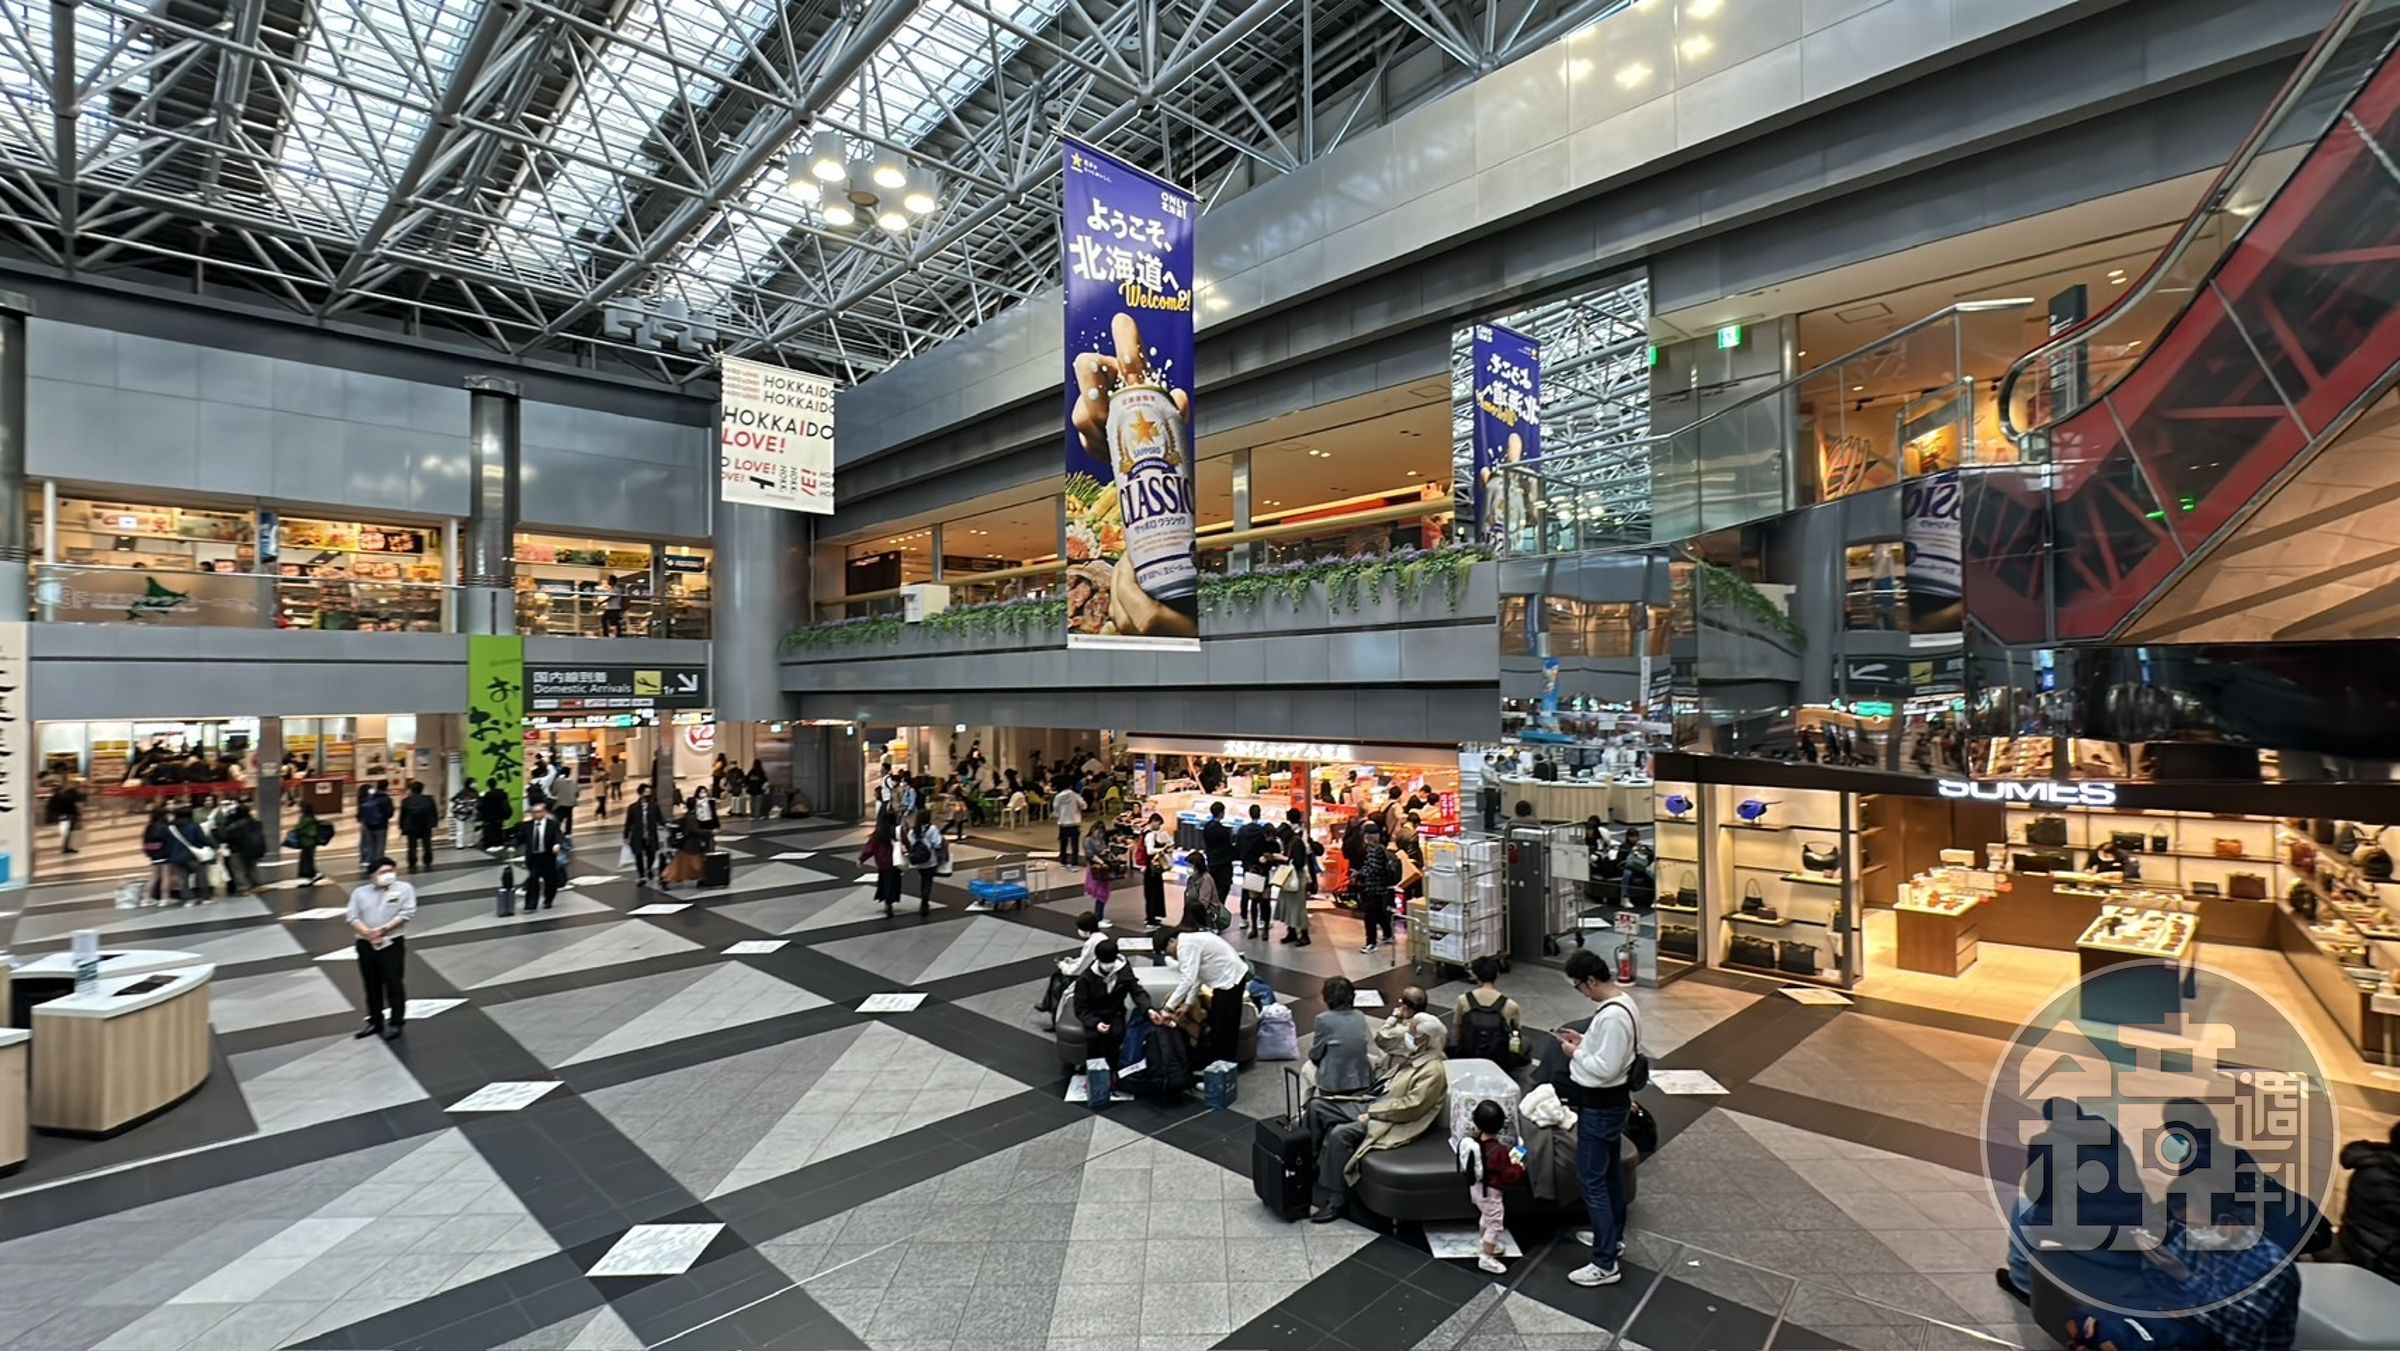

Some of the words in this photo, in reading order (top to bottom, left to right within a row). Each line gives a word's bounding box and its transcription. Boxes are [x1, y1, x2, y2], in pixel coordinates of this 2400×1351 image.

[1161, 191, 1188, 220] ONLY
[1087, 197, 1172, 253] ようこそ、
[1069, 235, 1180, 292] 北海道へ
[1119, 282, 1191, 311] Welcome!
[722, 405, 834, 440] HOKKAIDO
[722, 428, 787, 454] LOVE!
[734, 458, 777, 475] LOVE!
[533, 671, 608, 684] 国内線到着
[533, 683, 587, 694] Domestic
[589, 683, 632, 694] Arrivals
